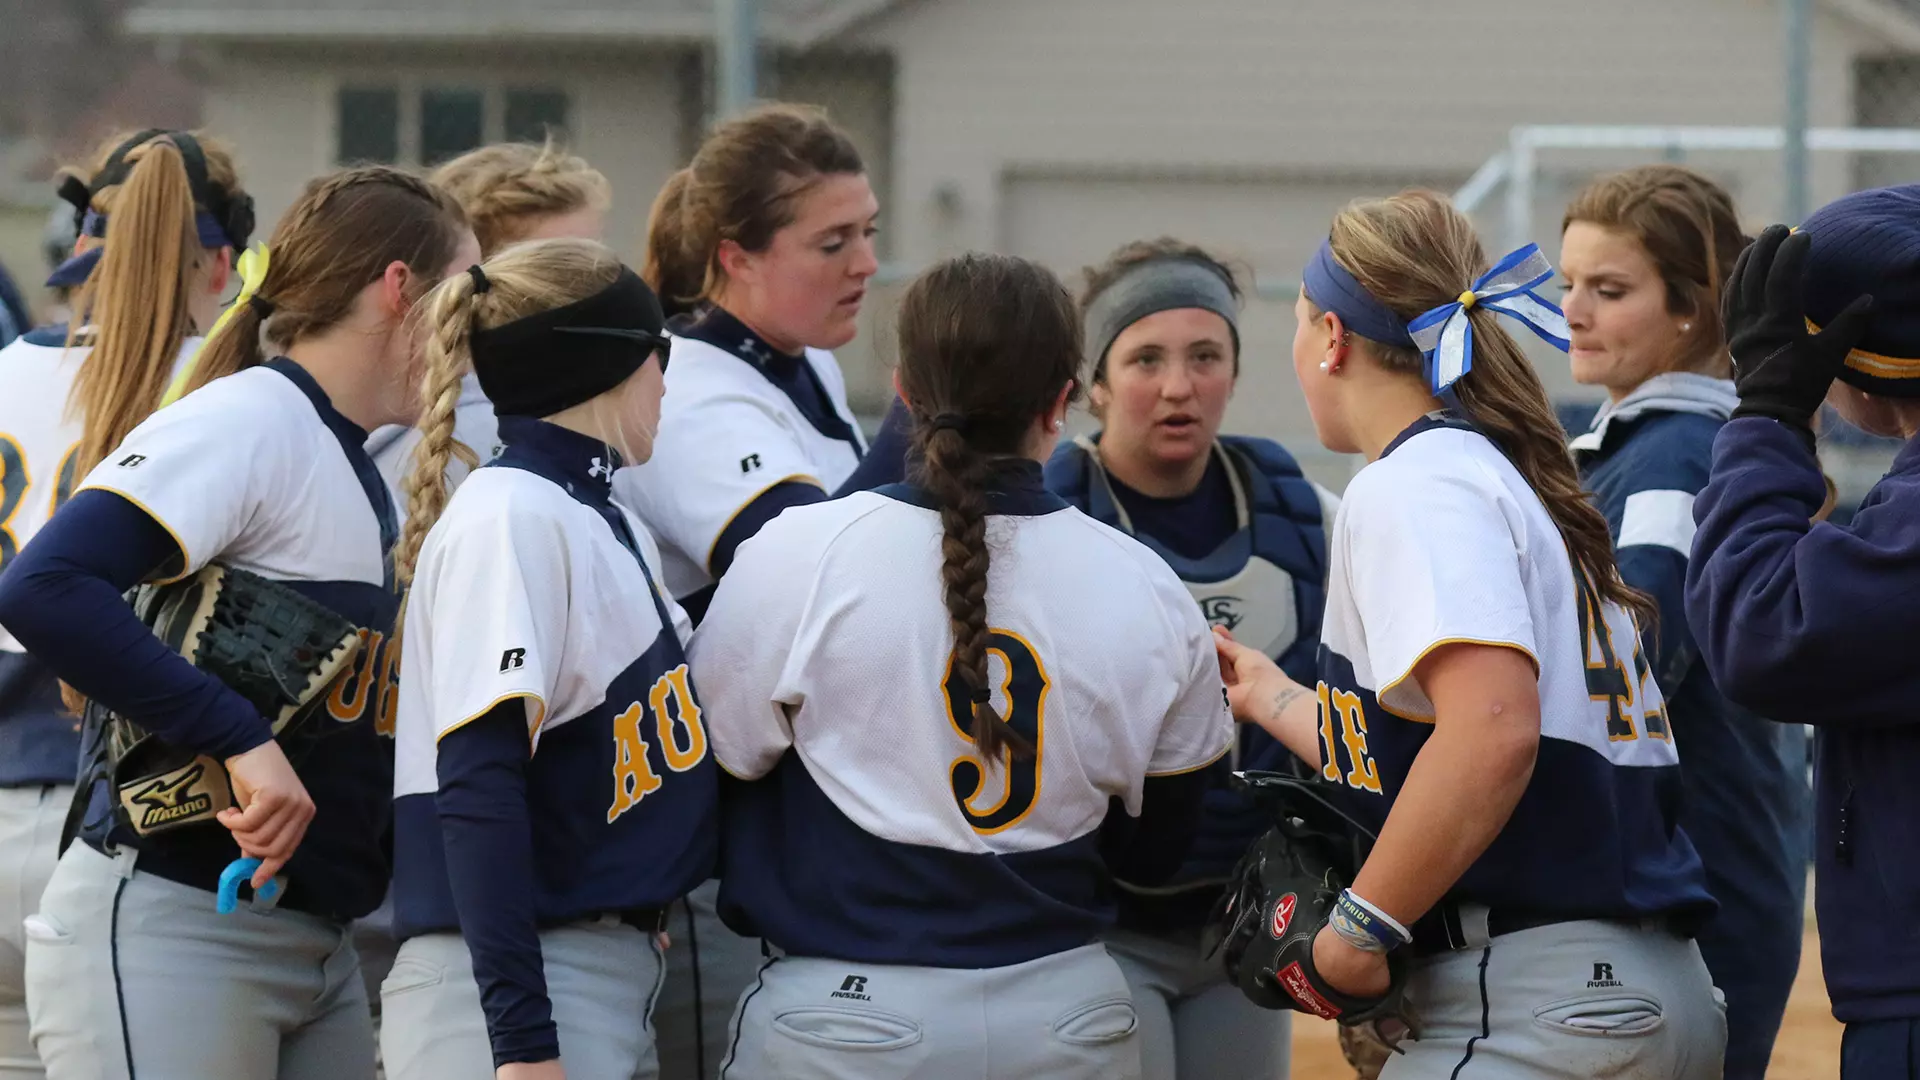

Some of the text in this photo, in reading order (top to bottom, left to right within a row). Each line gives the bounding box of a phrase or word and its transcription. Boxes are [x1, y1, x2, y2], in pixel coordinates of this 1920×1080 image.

[740, 453, 761, 473] R
[499, 647, 526, 674] R
[940, 627, 1051, 836] 9
[1344, 901, 1371, 926] PRIDE
[1592, 962, 1614, 981] R
[840, 974, 868, 993] R
[1586, 980, 1624, 988] RUSSELL
[830, 990, 872, 1002] RUSSELL
